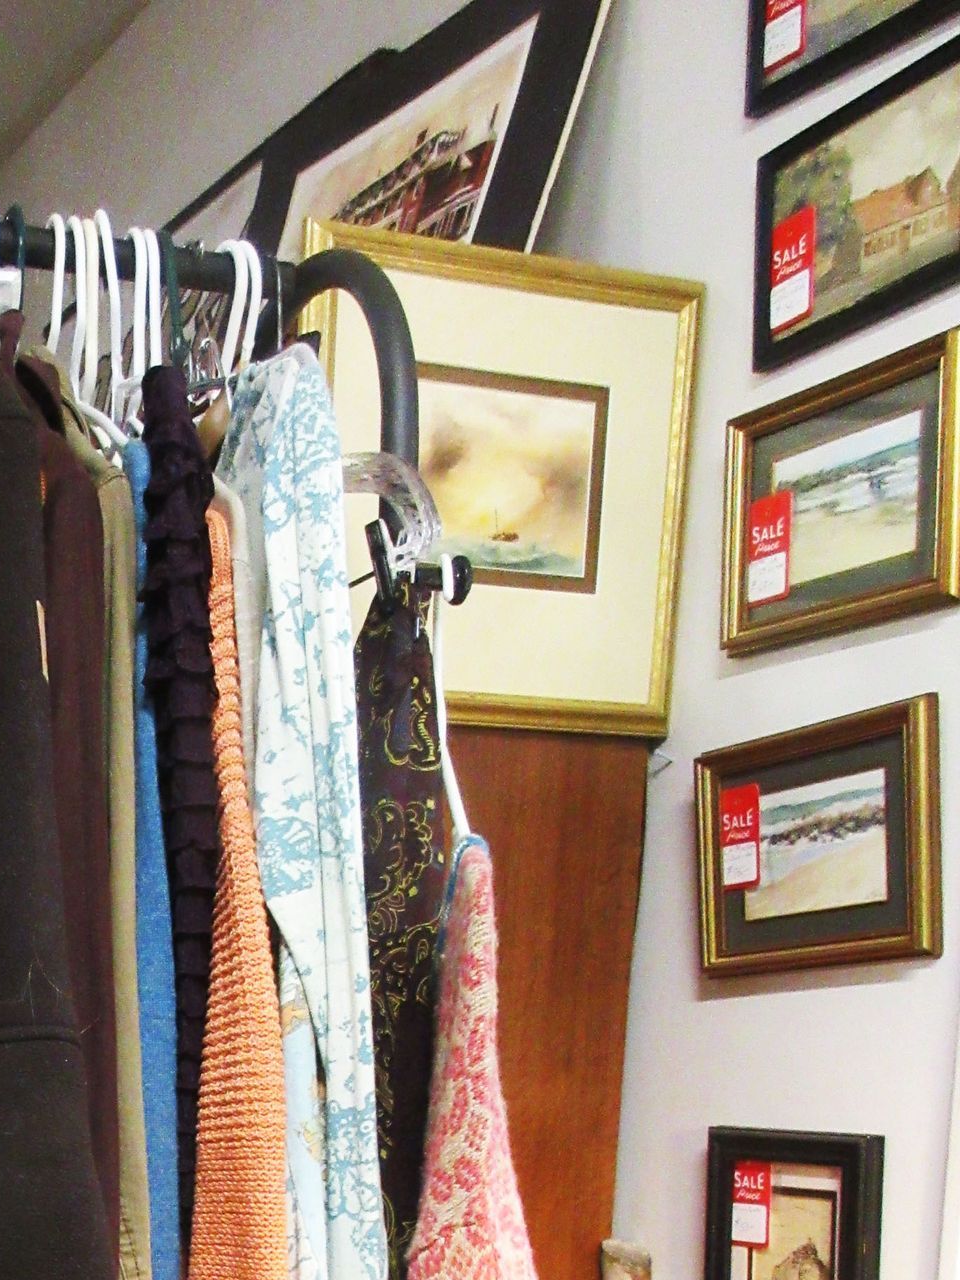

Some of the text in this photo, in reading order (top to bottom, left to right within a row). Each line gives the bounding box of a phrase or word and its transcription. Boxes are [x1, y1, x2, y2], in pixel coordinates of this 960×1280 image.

[772, 233, 808, 270] SALE
[751, 516, 785, 545] SALE
[754, 540, 781, 557] Price
[722, 807, 754, 831] SALE
[726, 829, 751, 843] Price
[734, 1170, 765, 1190] SALE
[736, 1188, 761, 1201] Price
